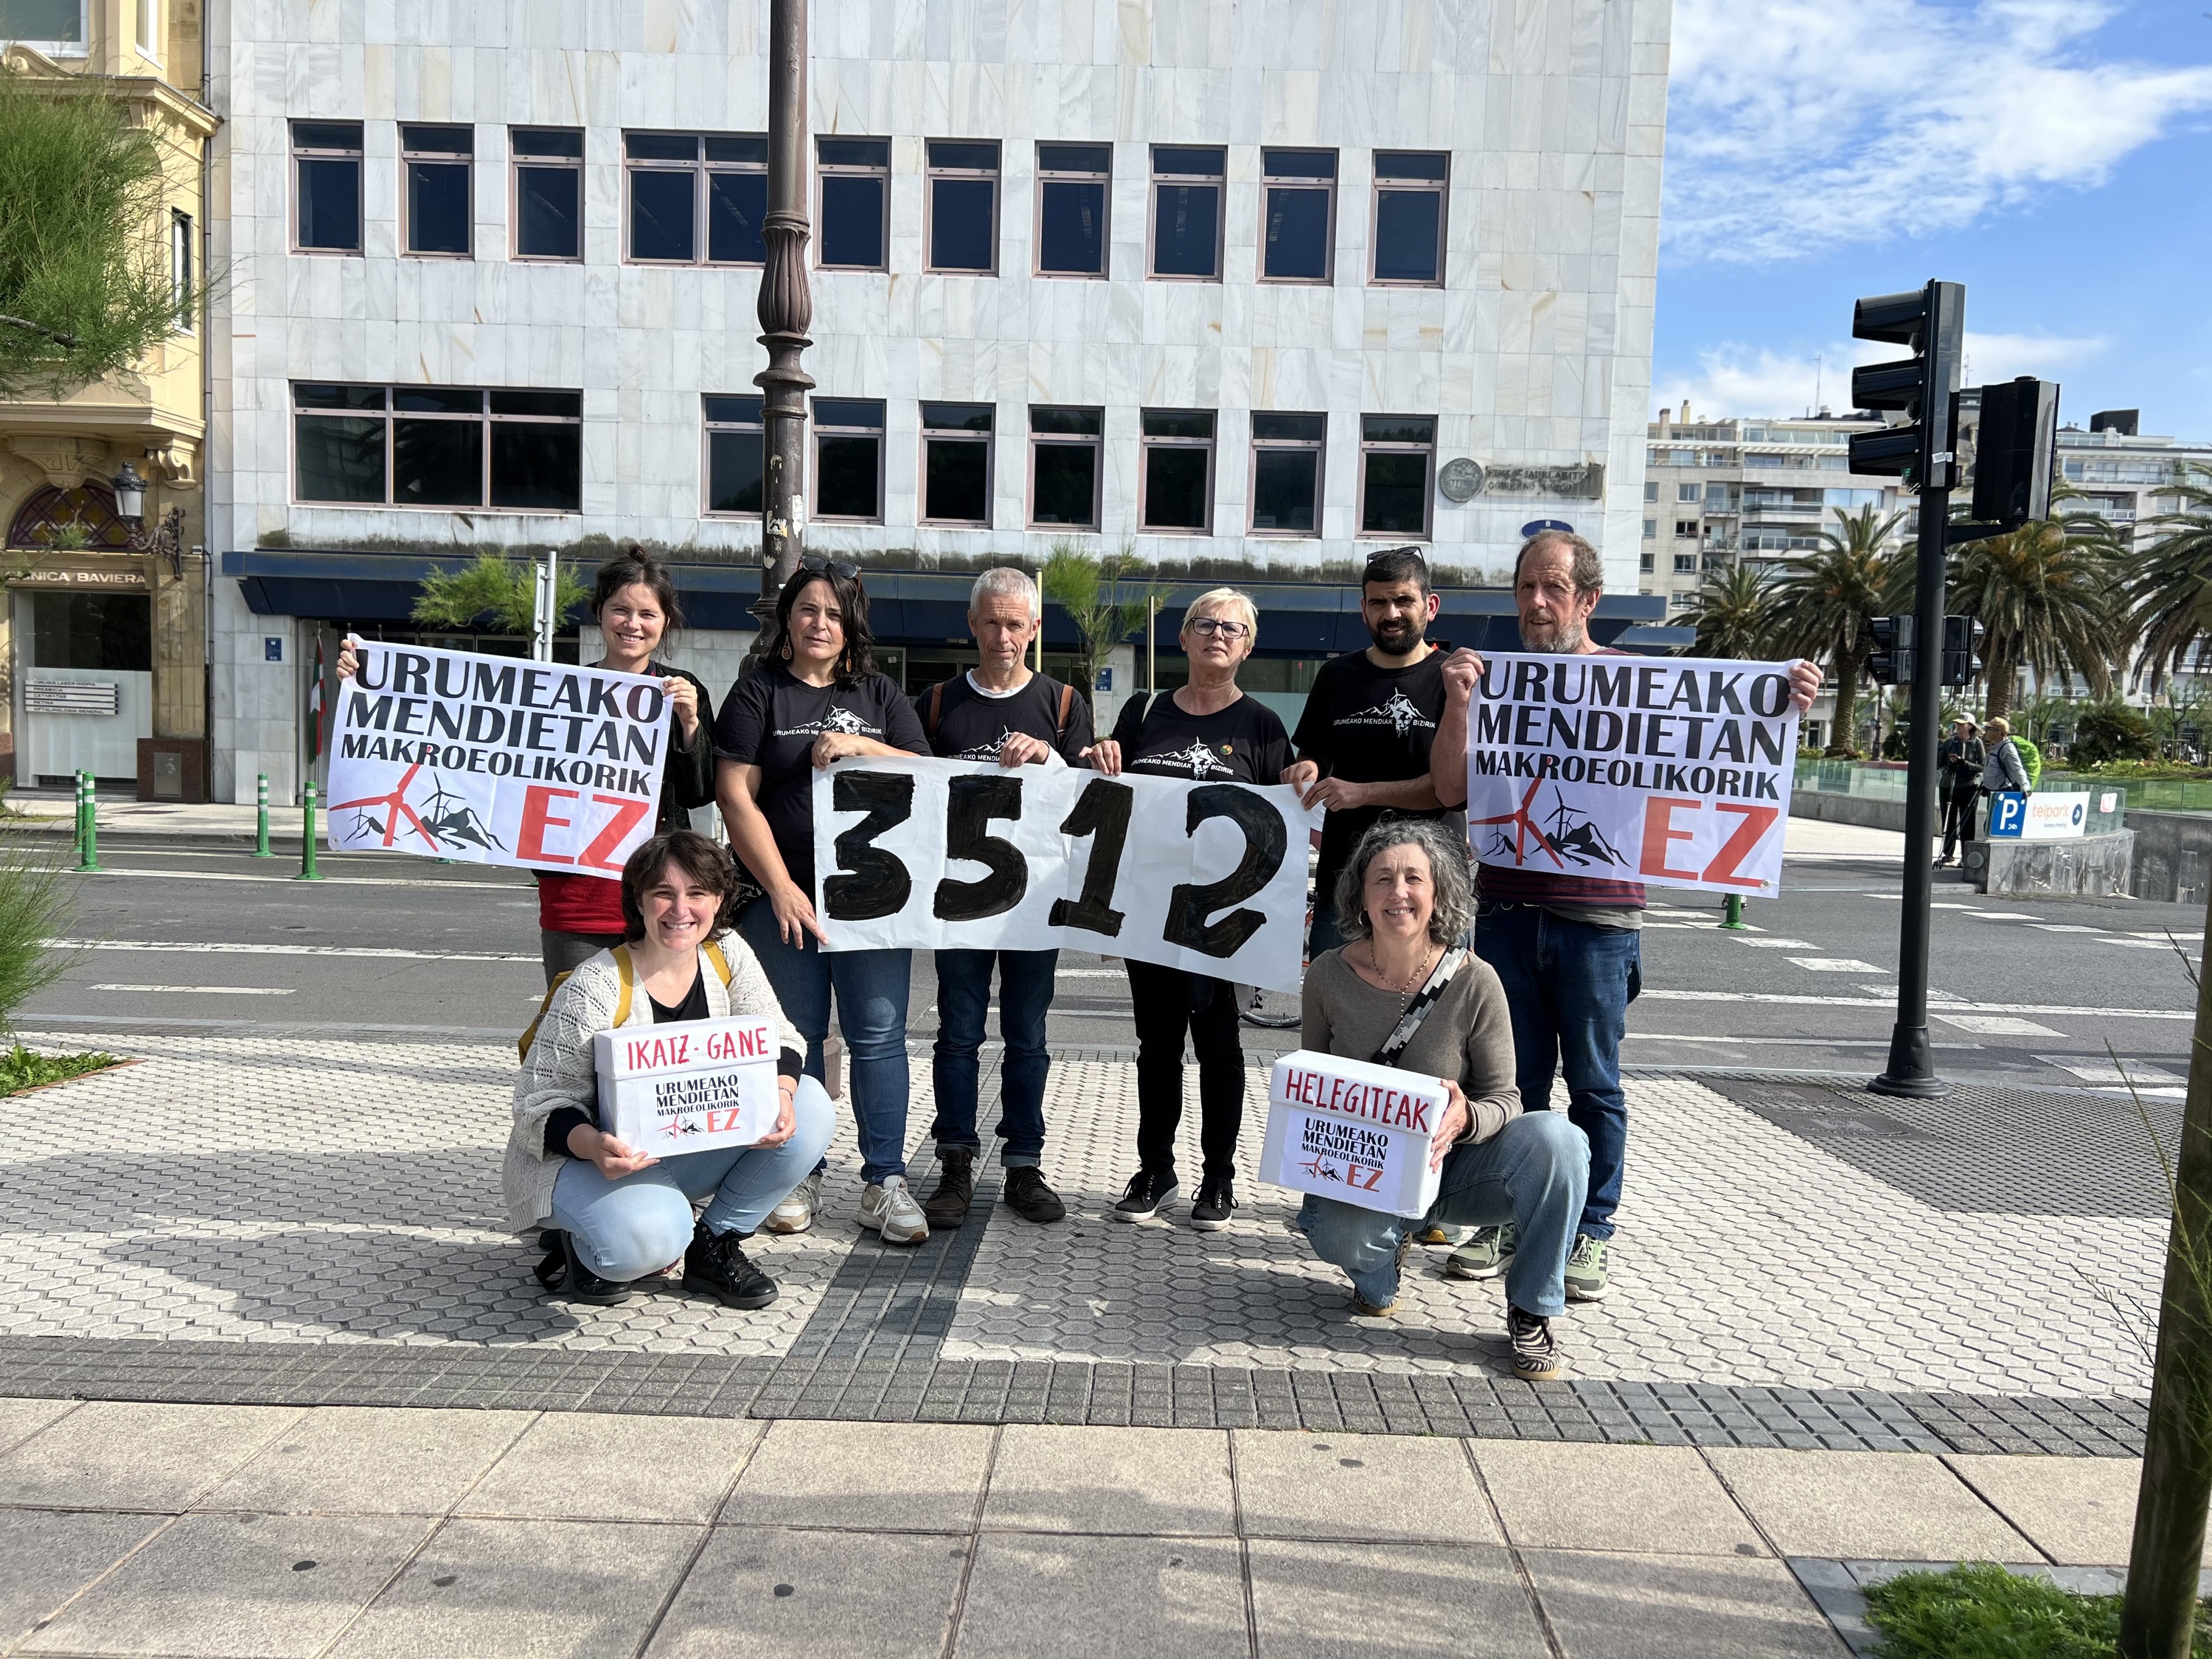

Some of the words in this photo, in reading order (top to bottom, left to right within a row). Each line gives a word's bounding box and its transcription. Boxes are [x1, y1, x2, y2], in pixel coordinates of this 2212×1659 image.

[1488, 481, 1536, 490] GOBIERNO
[77, 572, 145, 583] BAVIERA
[355, 649, 664, 723] URUMEAKO
[1481, 659, 1790, 718] URUMEAKO
[346, 691, 658, 766] MENDIETAN
[811, 727, 841, 736] MEDIAK
[861, 726, 883, 734] BIZIRIK
[1333, 718, 1362, 726] URUMEAKO
[1413, 720, 1436, 728] BIZIRIK
[1477, 703, 1787, 766] MENDIETAN
[341, 734, 651, 796] MAKROEOLIKORIK
[1131, 758, 1161, 766] URUMEAKO
[1162, 760, 1192, 769] MENDIAK
[1211, 764, 1234, 775] BIZIRIK
[1475, 750, 1780, 800] MAKROEOLIKORIK
[1999, 799, 2018, 830] P
[2032, 804, 2070, 821] telpark
[516, 785, 650, 872] EZ
[1638, 796, 1778, 888] EZ
[823, 770, 1287, 959] 3512
[655, 1074, 738, 1096] URUMEAKO
[656, 1086, 739, 1108] MENDIETAN
[657, 1099, 740, 1117] MAKROEOLIKORIK
[1285, 1068, 1430, 1133] HELEGITEAK
[706, 1108, 740, 1133] EZ
[1305, 1117, 1388, 1147] URUMEAKO
[1301, 1142, 1384, 1170] MAKROEOLIKORIK
[1302, 1130, 1387, 1161] MENDIETAN
[1346, 1164, 1384, 1193] EZ
